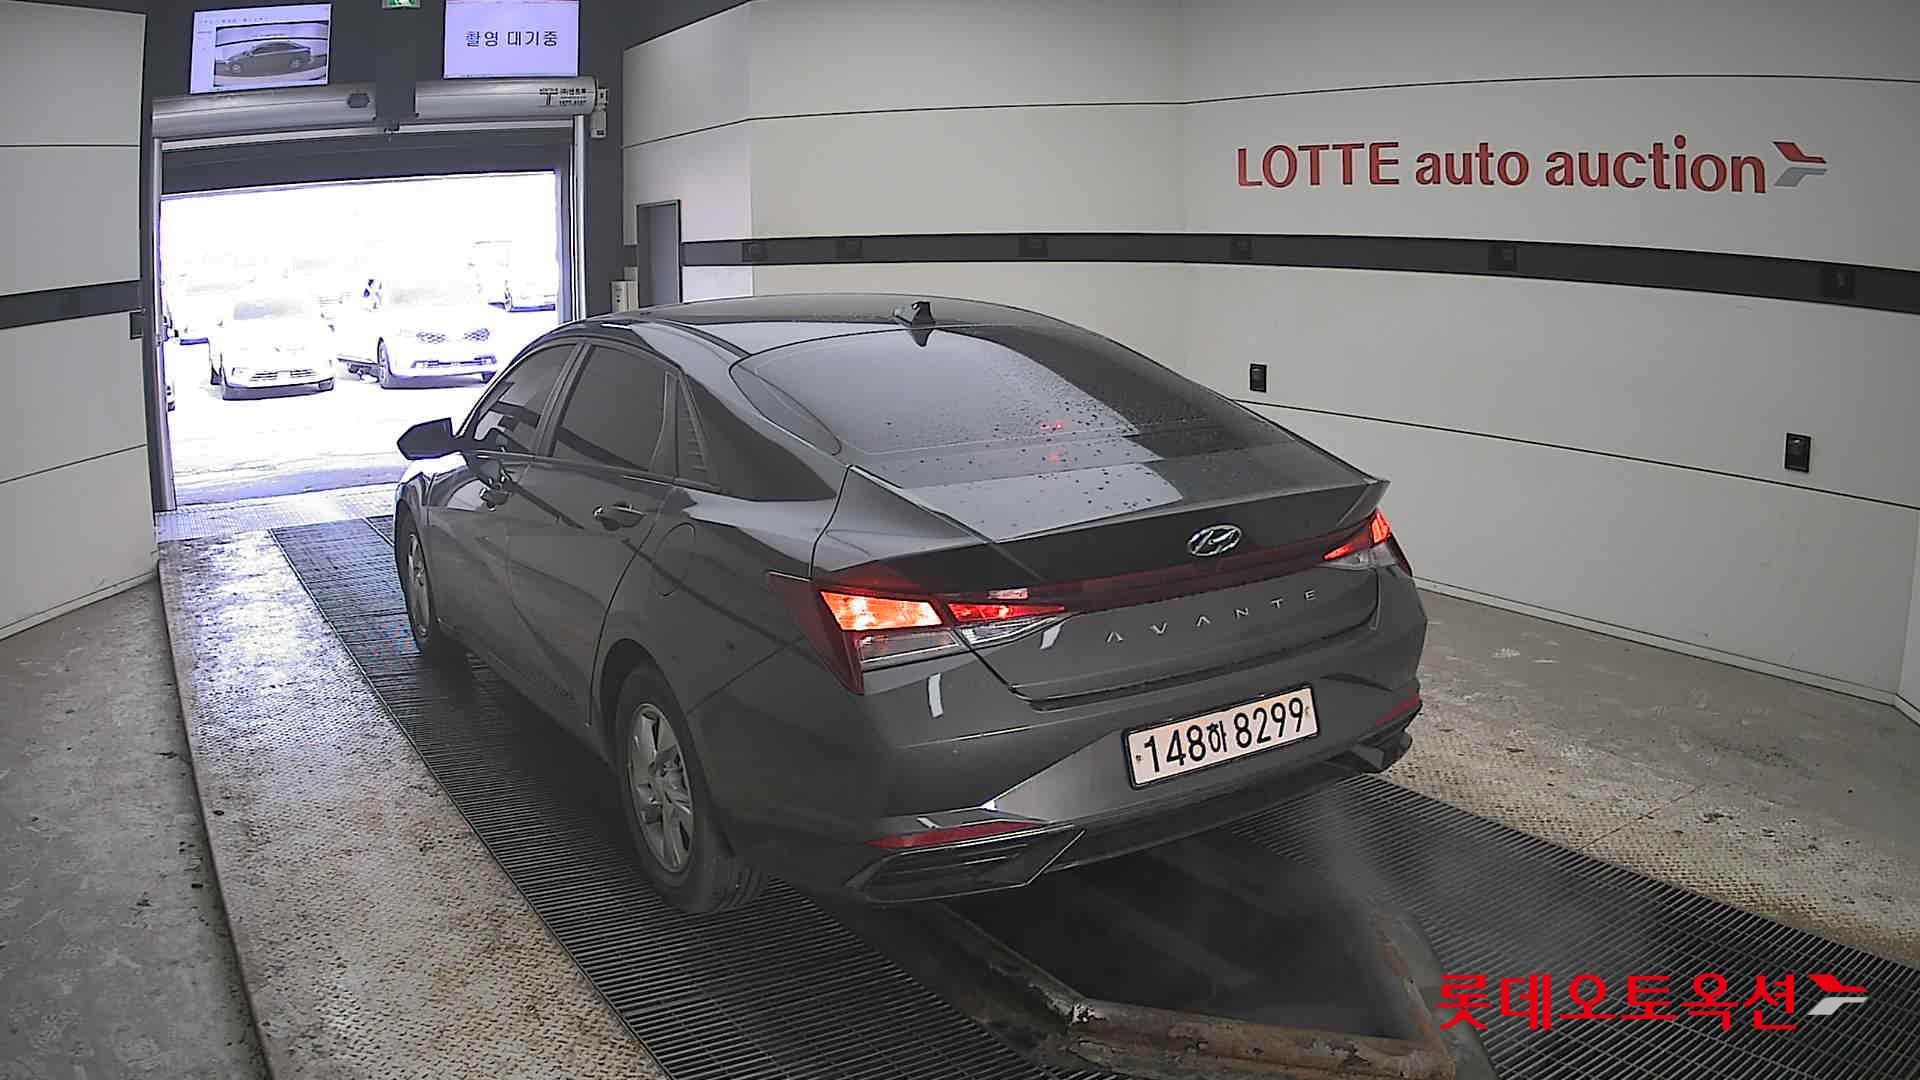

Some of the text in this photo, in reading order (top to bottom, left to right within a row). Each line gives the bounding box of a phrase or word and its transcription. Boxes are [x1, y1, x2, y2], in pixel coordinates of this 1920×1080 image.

[507, 31, 558, 47] 대기중
[1237, 135, 1766, 193] LOTTE auto auction
[1106, 590, 1317, 643] AVANTE
